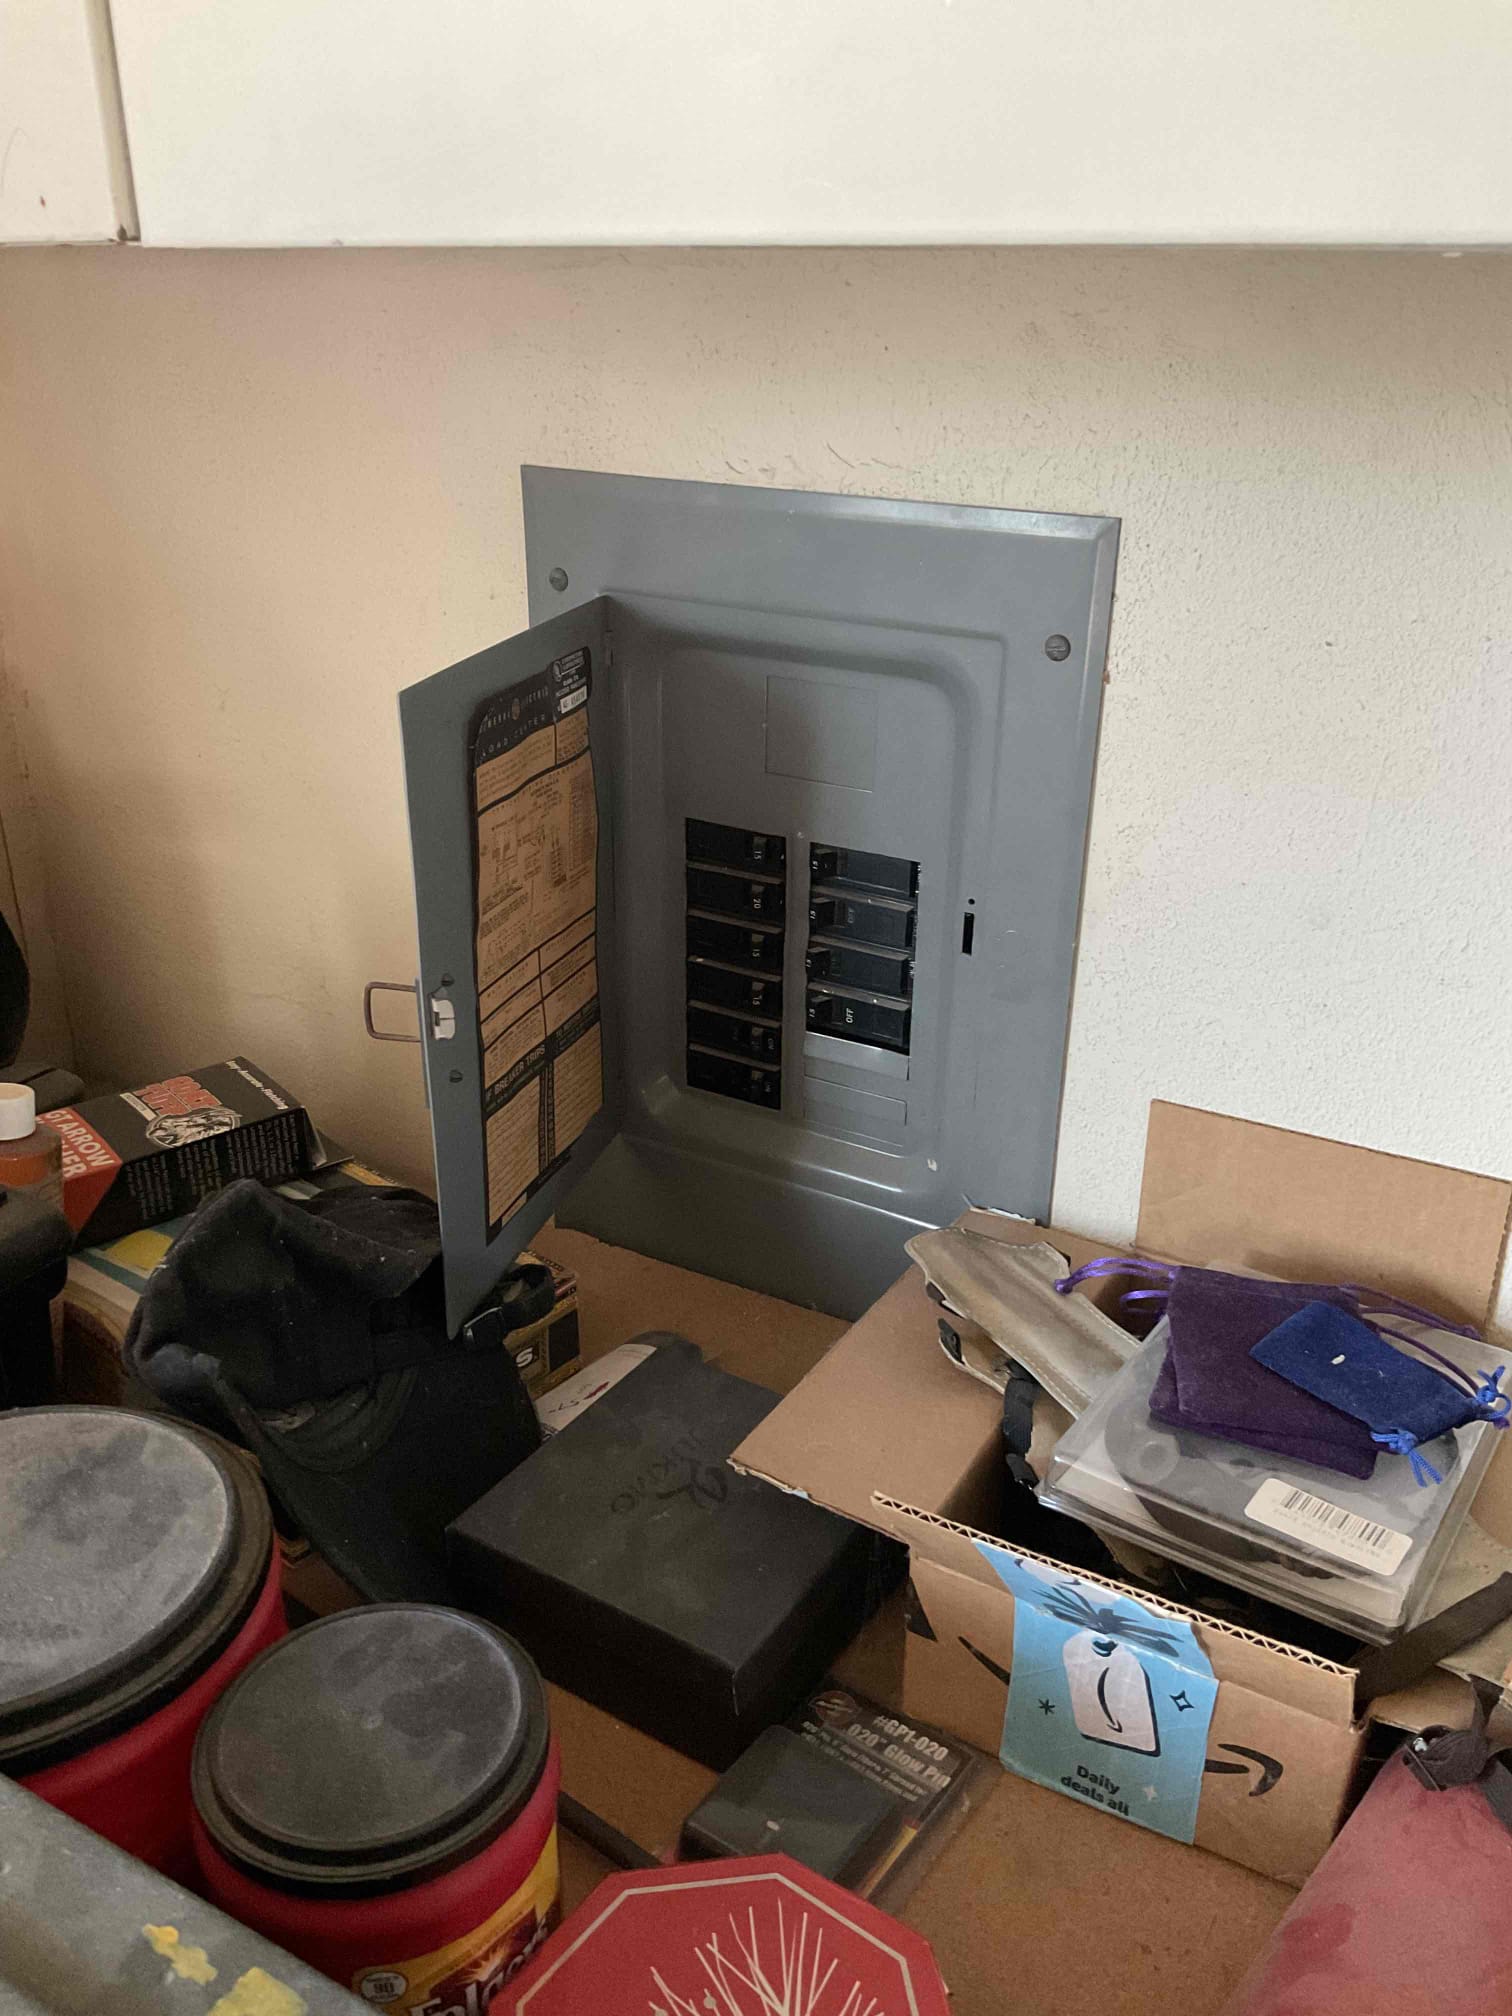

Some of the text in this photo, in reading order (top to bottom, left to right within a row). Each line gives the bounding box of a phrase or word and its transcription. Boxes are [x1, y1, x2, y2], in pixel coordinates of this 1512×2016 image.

[753, 898, 761, 909] 20
[845, 1007, 854, 1024] OFF
[494, 1061, 525, 1096] BREAKER
[45, 1110, 73, 1123] GT
[56, 1121, 115, 1167] ARROW
[873, 1715, 949, 1761] #GP1-020
[884, 1744, 926, 1772] Glow
[1077, 1765, 1120, 1795] Daily
[1061, 1776, 1129, 1817] deals all
